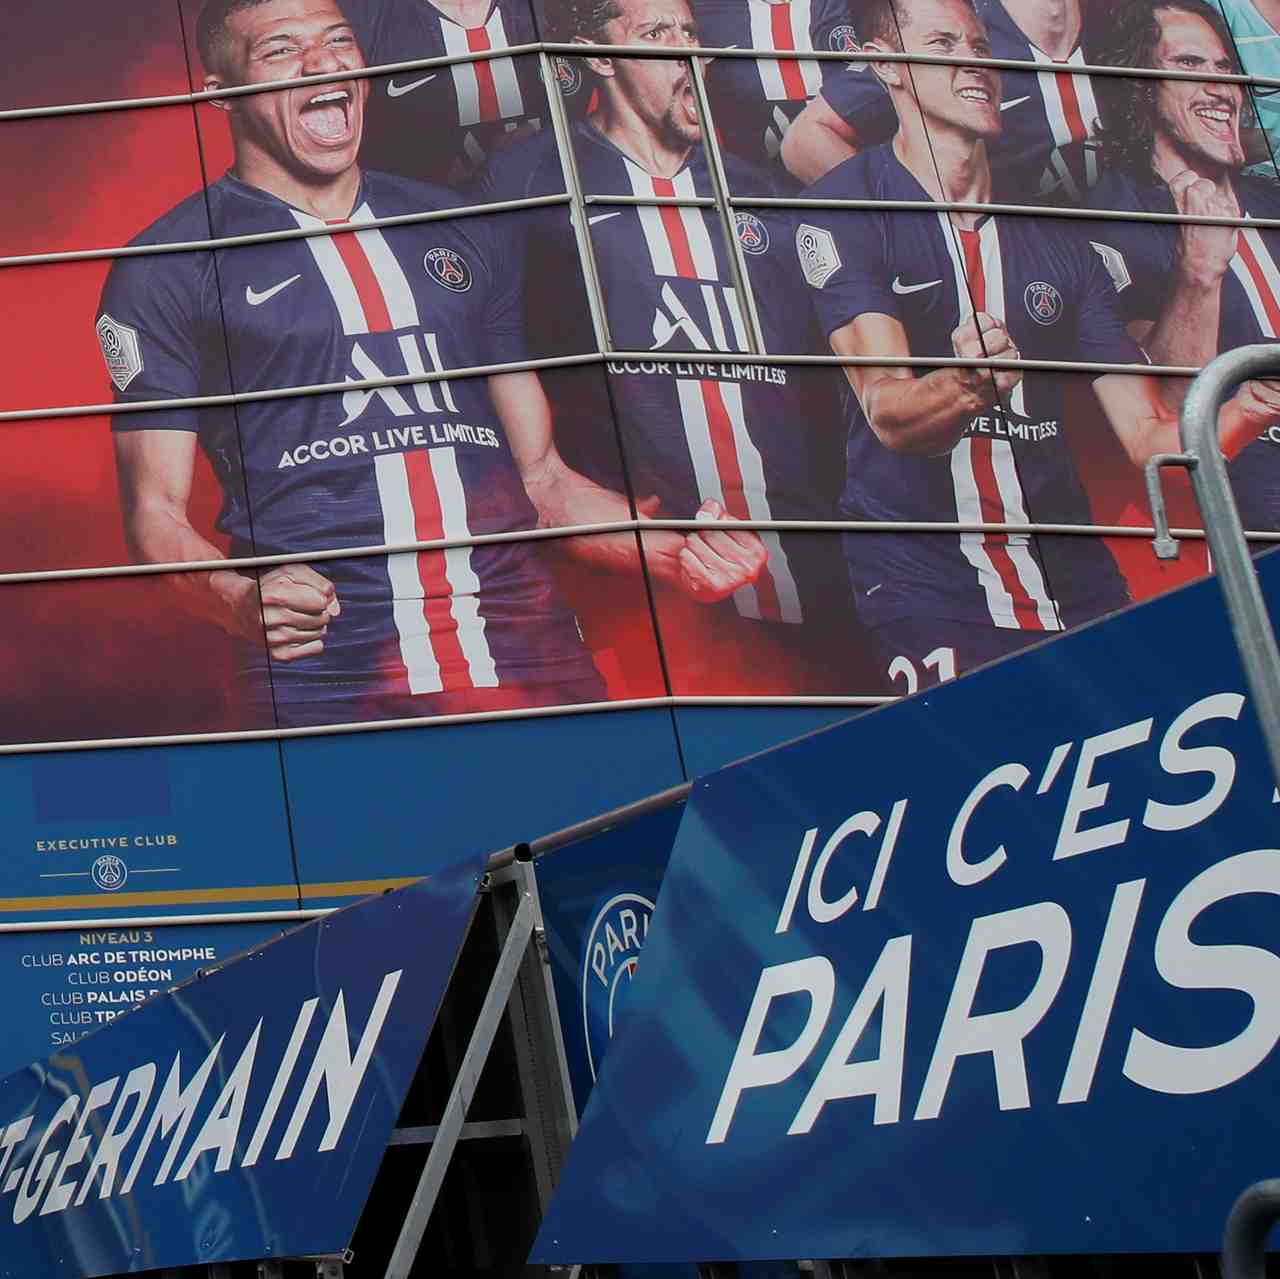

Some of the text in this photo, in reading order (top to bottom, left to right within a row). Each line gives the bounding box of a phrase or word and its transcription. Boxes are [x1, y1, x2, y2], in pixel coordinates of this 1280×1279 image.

[721, 363, 787, 385] LIMITLESS
[278, 422, 501, 469] ACCOR LIVE LIMITLESS
[775, 692, 1246, 935] ICI C'ES
[36, 834, 178, 852] EXECUTIVE CLUB
[79, 930, 153, 945] NIVEAU 3
[592, 909, 649, 987] PARI
[21, 947, 217, 968] CLUB ARC DE TRIOMPHE
[68, 967, 172, 985] CLUB ODÉON
[41, 992, 84, 1006] CLUB
[87, 989, 146, 1004] PALAIS
[704, 848, 1280, 1145] PARIS
[50, 1011, 93, 1025] CLUB
